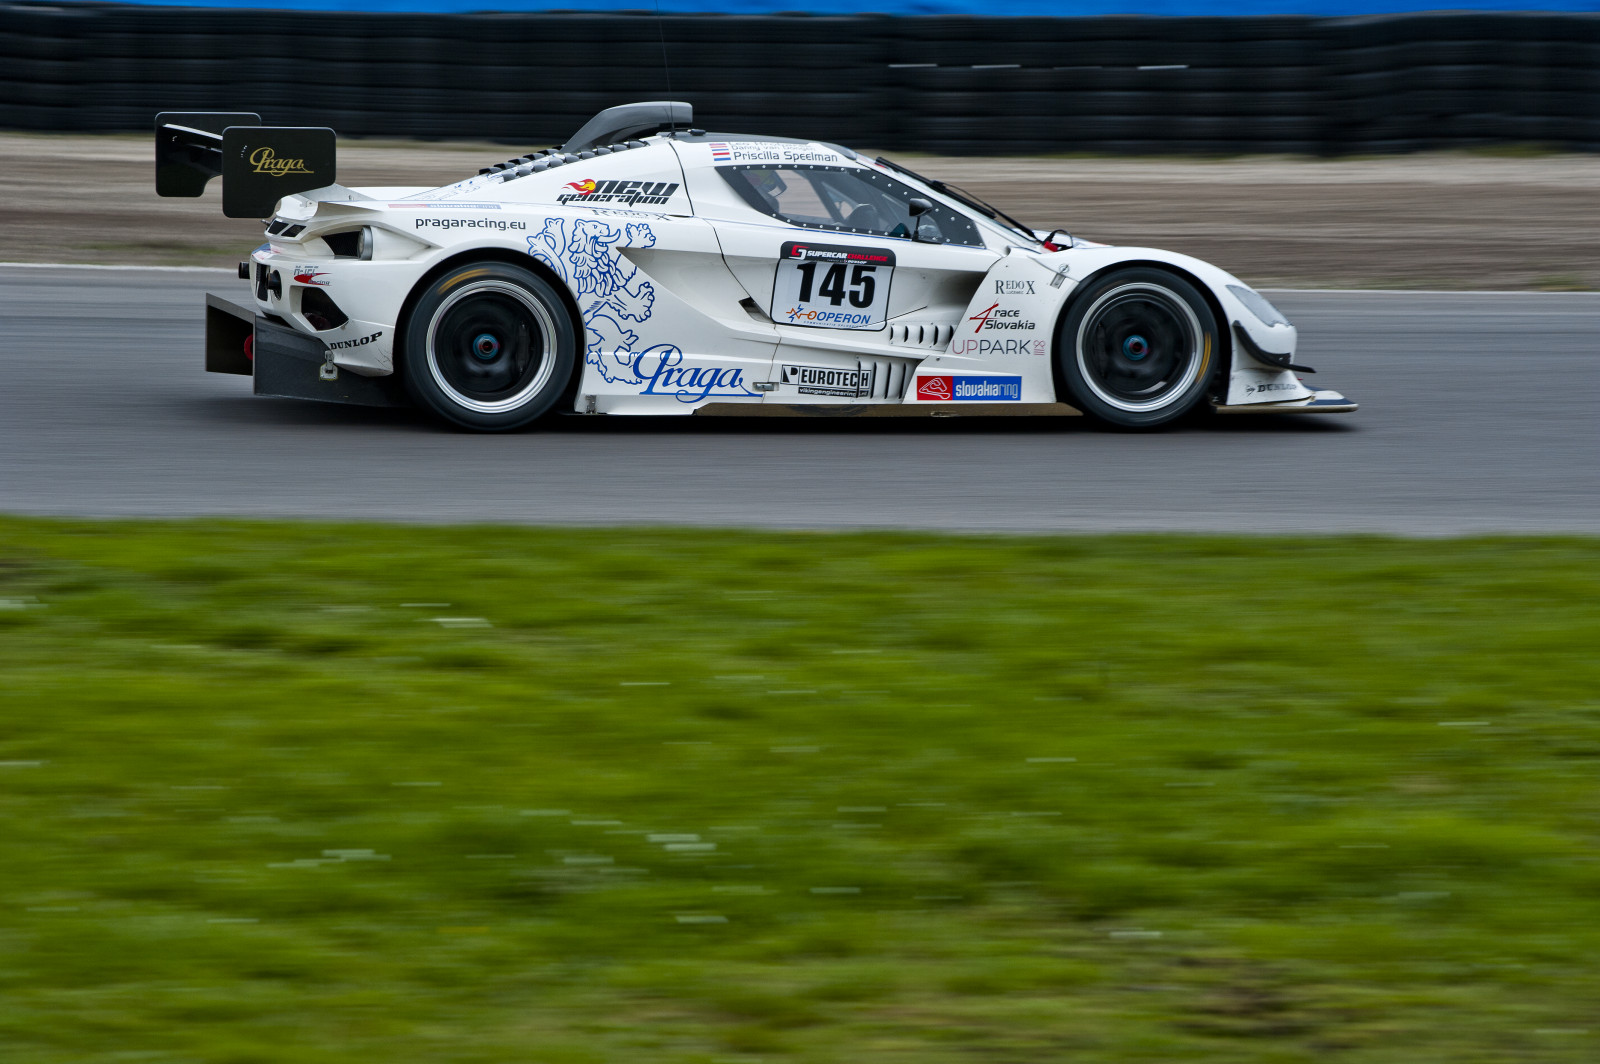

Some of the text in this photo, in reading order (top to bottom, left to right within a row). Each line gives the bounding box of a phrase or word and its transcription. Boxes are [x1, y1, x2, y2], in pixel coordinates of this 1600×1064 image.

[249, 146, 314, 176] Praga
[733, 151, 838, 162] Priscilla Speelman
[592, 180, 679, 196] new
[556, 192, 670, 207] generation
[415, 218, 526, 231] pragaracing.eu
[796, 261, 877, 309] 145
[984, 320, 1036, 330] Slovakia
[329, 331, 382, 350] DUNLOP
[952, 339, 1031, 355] UPPARK
[632, 343, 763, 404] Praga
[801, 368, 869, 387] EUROTECH
[955, 380, 1018, 399] slovakiaring
